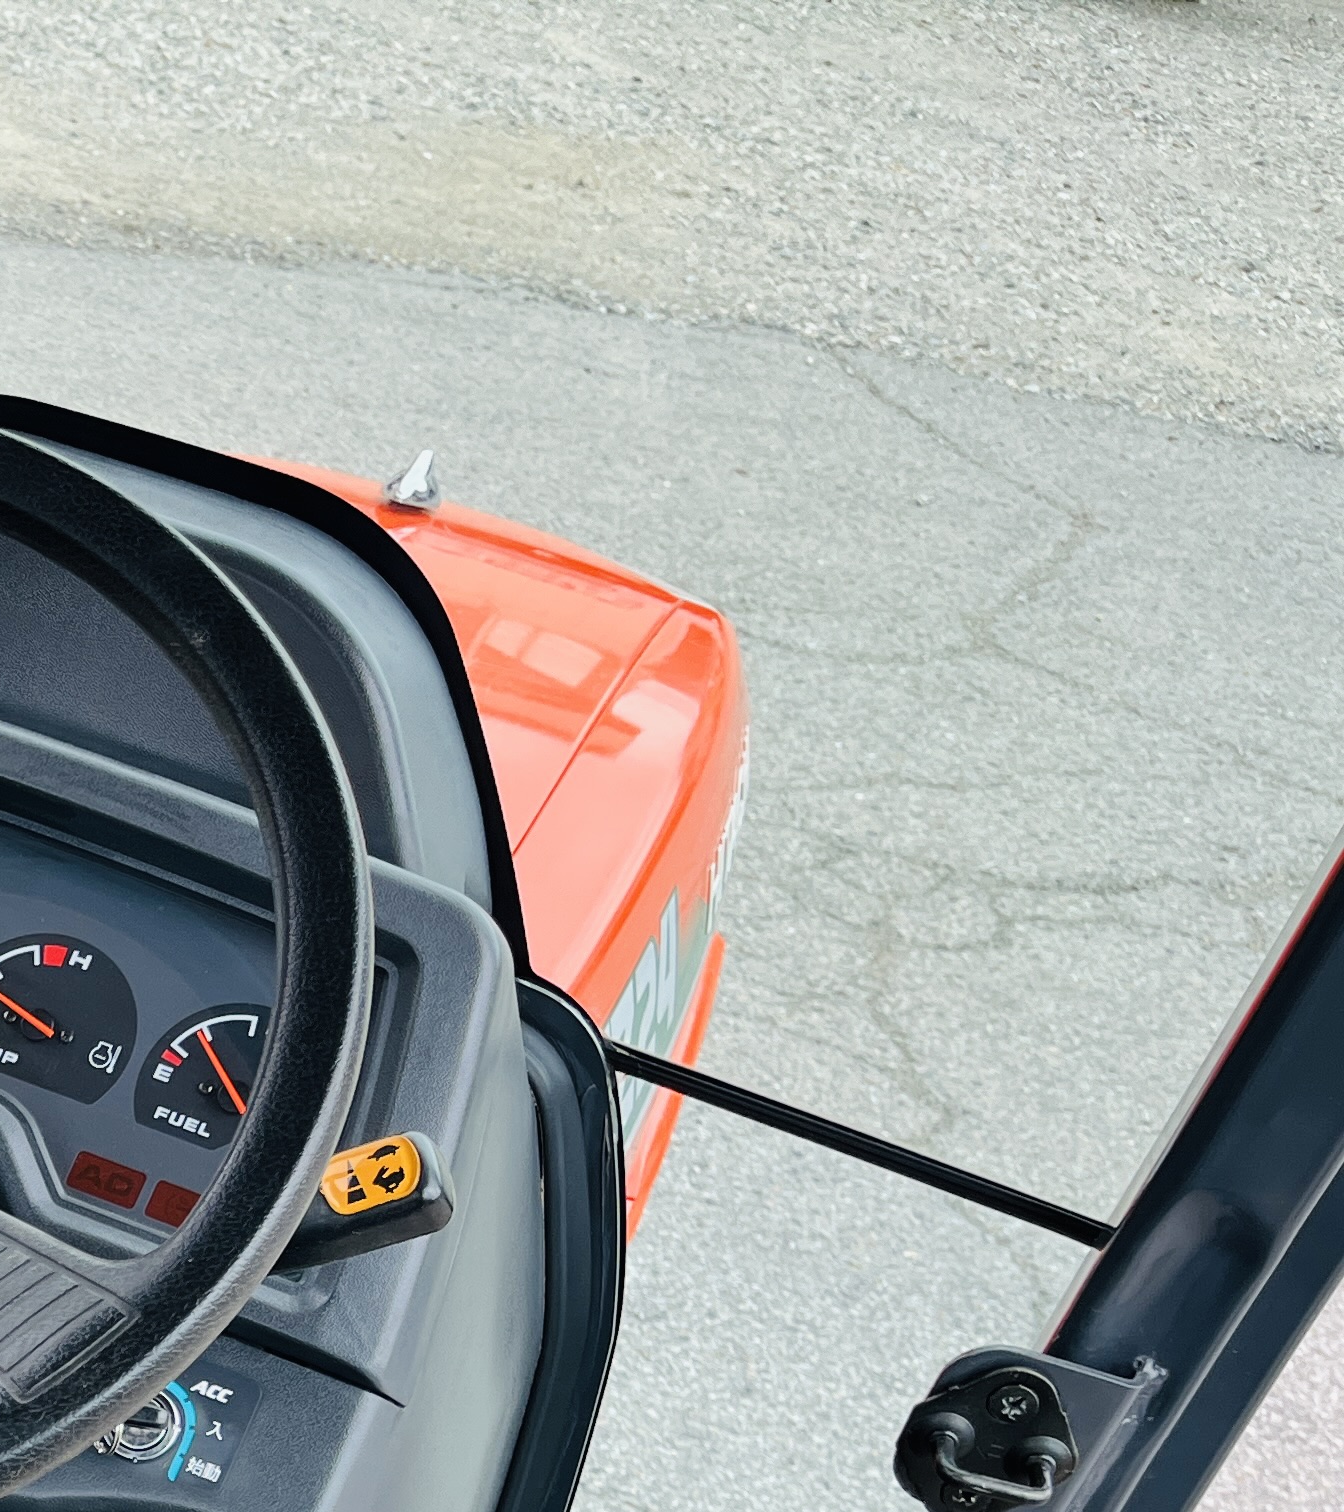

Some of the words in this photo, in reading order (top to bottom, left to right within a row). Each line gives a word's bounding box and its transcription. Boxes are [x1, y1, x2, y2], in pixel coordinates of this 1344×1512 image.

[68, 950, 93, 971] H
[152, 1062, 174, 1084] E
[153, 1105, 211, 1139] FUEL
[189, 1379, 234, 1404] ACC
[184, 1456, 223, 1483] 始動
